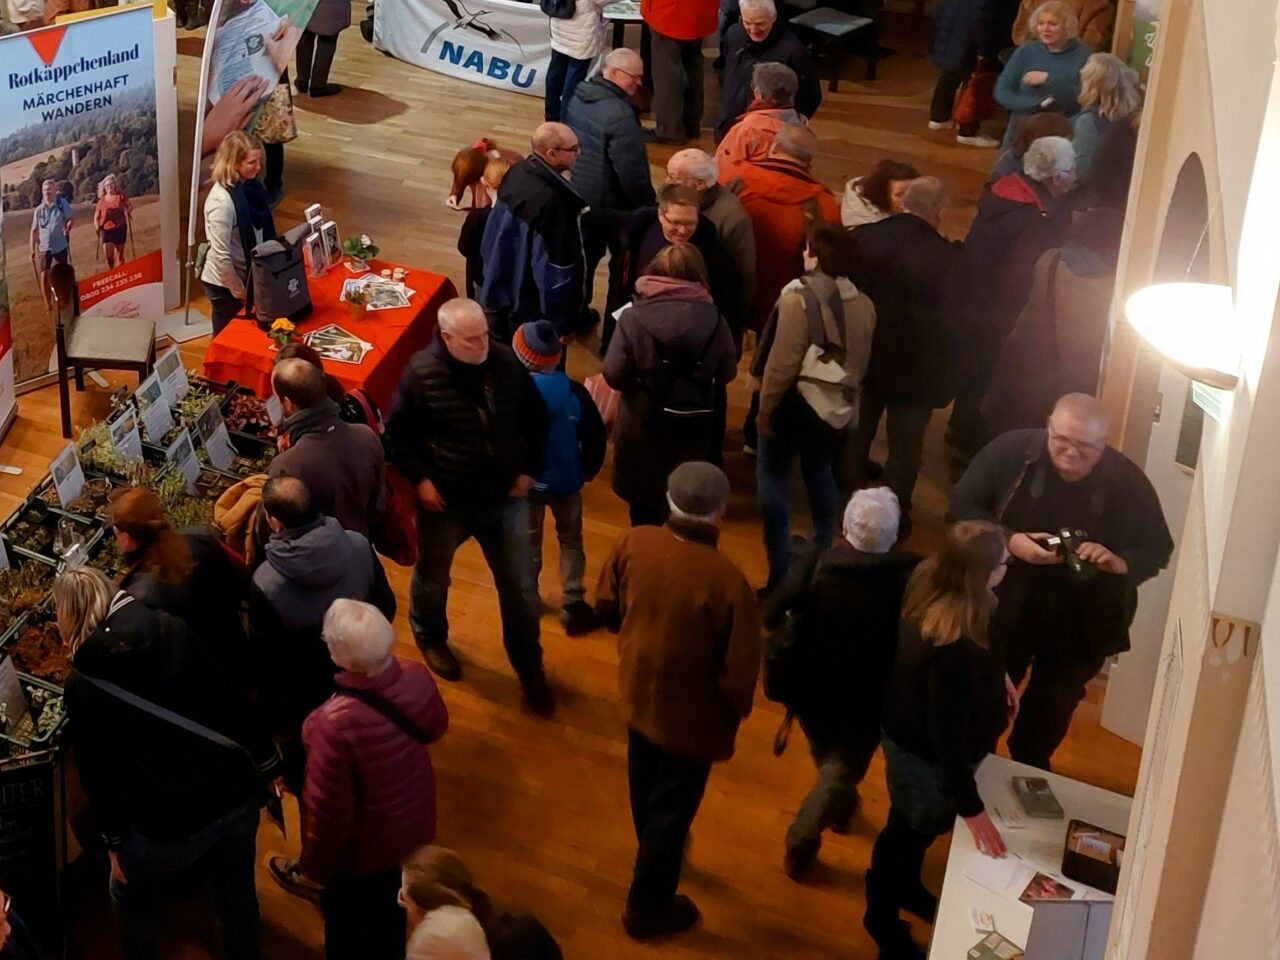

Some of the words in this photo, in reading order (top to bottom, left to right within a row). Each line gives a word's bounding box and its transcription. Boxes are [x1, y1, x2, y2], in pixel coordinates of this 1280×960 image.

[8, 43, 140, 90] Rotkäppchenland
[438, 40, 538, 89] NABU
[23, 74, 130, 111] MÄRCHENHAFT
[41, 95, 113, 122] WANDERN
